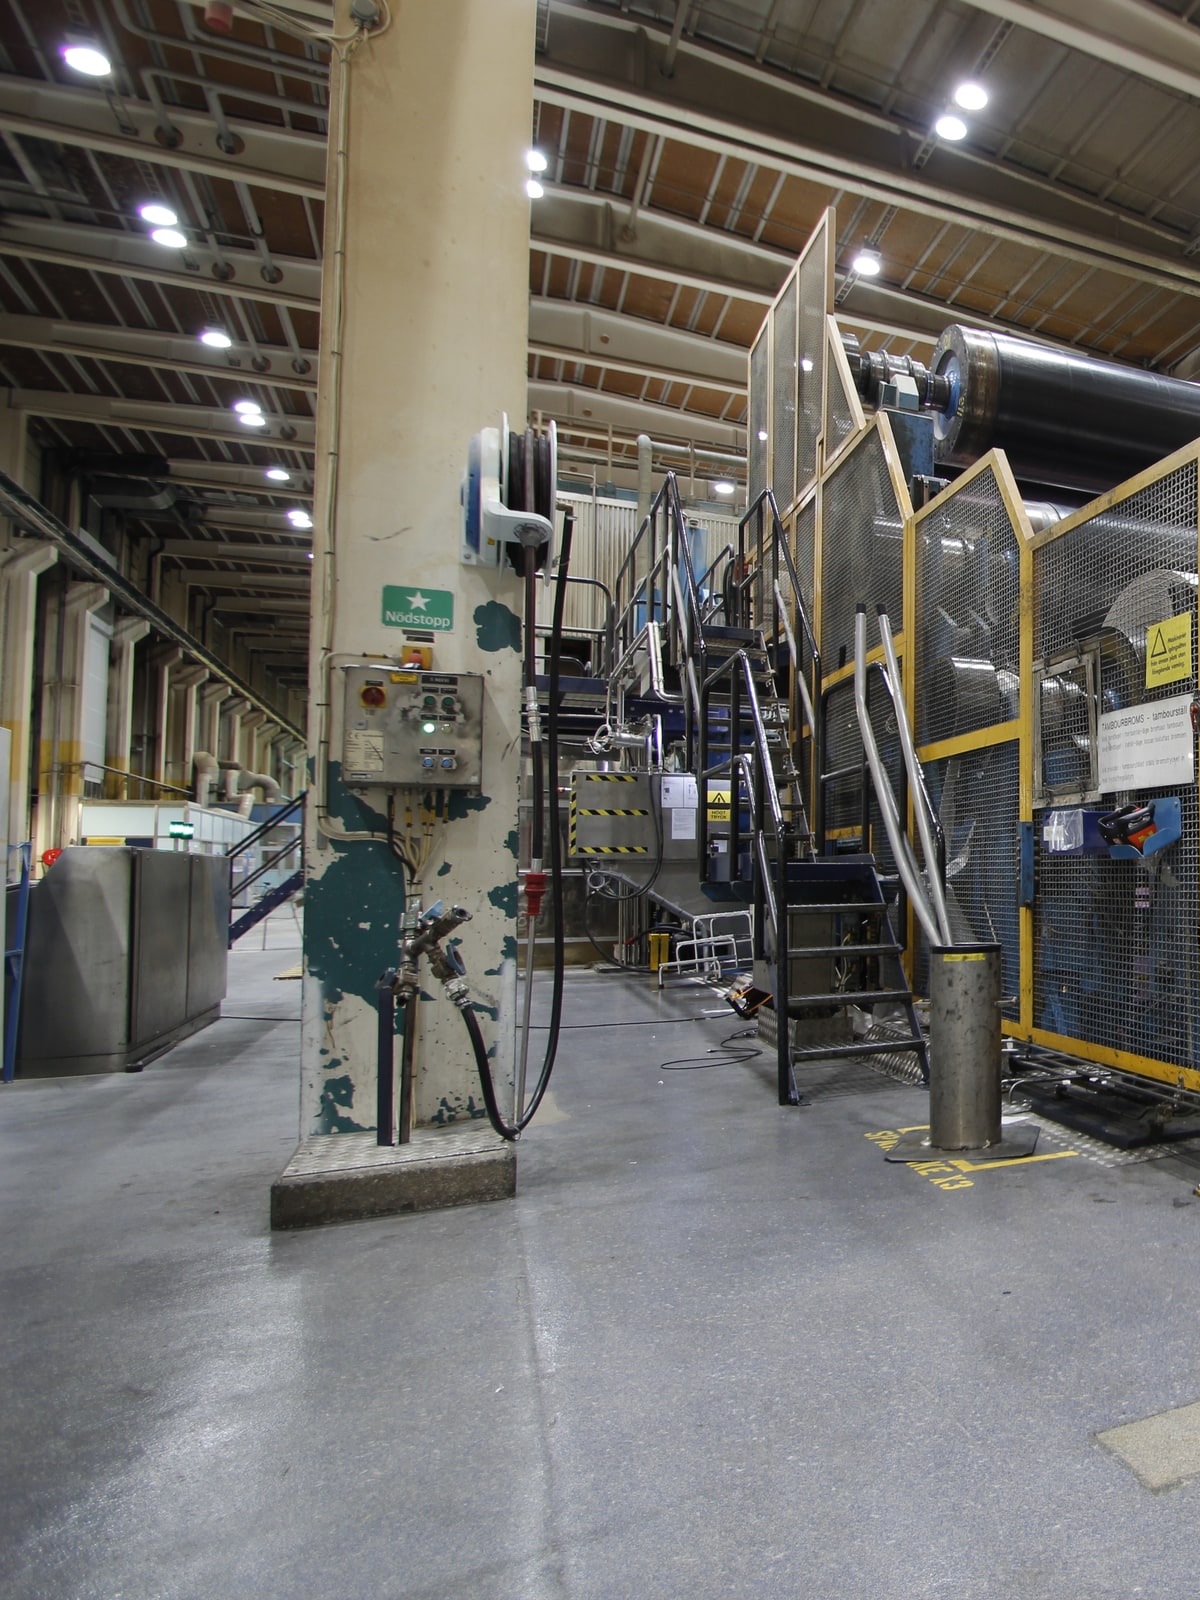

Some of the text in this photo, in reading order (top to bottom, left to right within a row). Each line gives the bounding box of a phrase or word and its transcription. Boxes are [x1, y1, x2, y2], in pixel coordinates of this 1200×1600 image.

[385, 610, 450, 629] Nödstopp
[1102, 714, 1145, 730] TAMBOURBROMS
[1152, 705, 1187, 721] tambourställ
